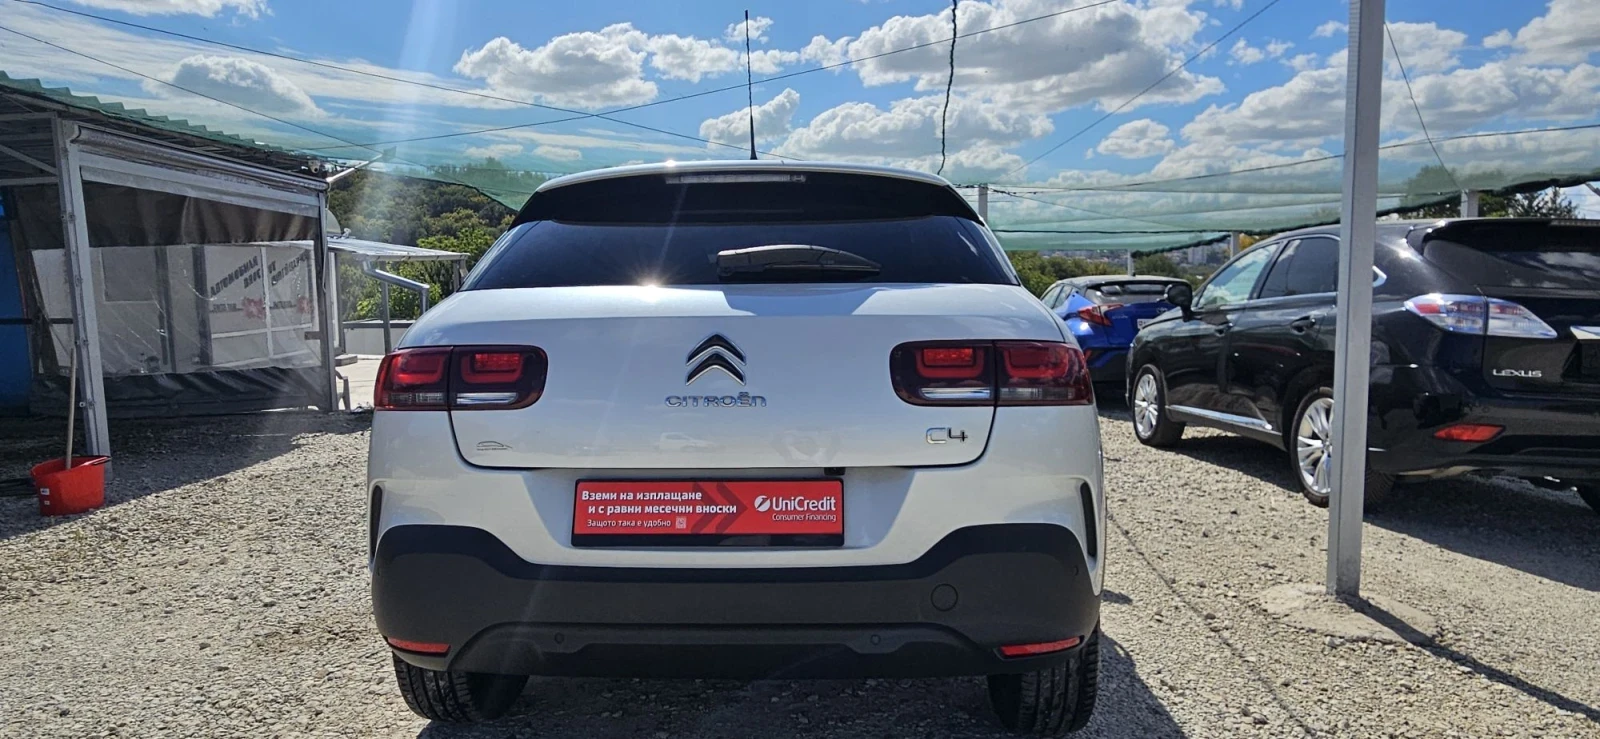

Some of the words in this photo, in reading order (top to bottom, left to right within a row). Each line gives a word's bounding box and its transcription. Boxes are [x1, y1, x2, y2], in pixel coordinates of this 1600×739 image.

[1493, 369, 1542, 378] LEXUS
[926, 427, 969, 445] C4
[582, 490, 617, 500] Вземи
[620, 491, 634, 500] на
[636, 491, 703, 502] изплащане
[772, 496, 836, 511] UniCredit
[588, 505, 596, 514] и
[598, 505, 605, 514] с
[607, 505, 642, 516] равни
[644, 504, 693, 514] месечни
[695, 504, 737, 514] вноски
[587, 519, 616, 528] Защото
[643, 519, 671, 528] удобно
[772, 513, 804, 521] Consumer
[805, 513, 837, 523] Financing
